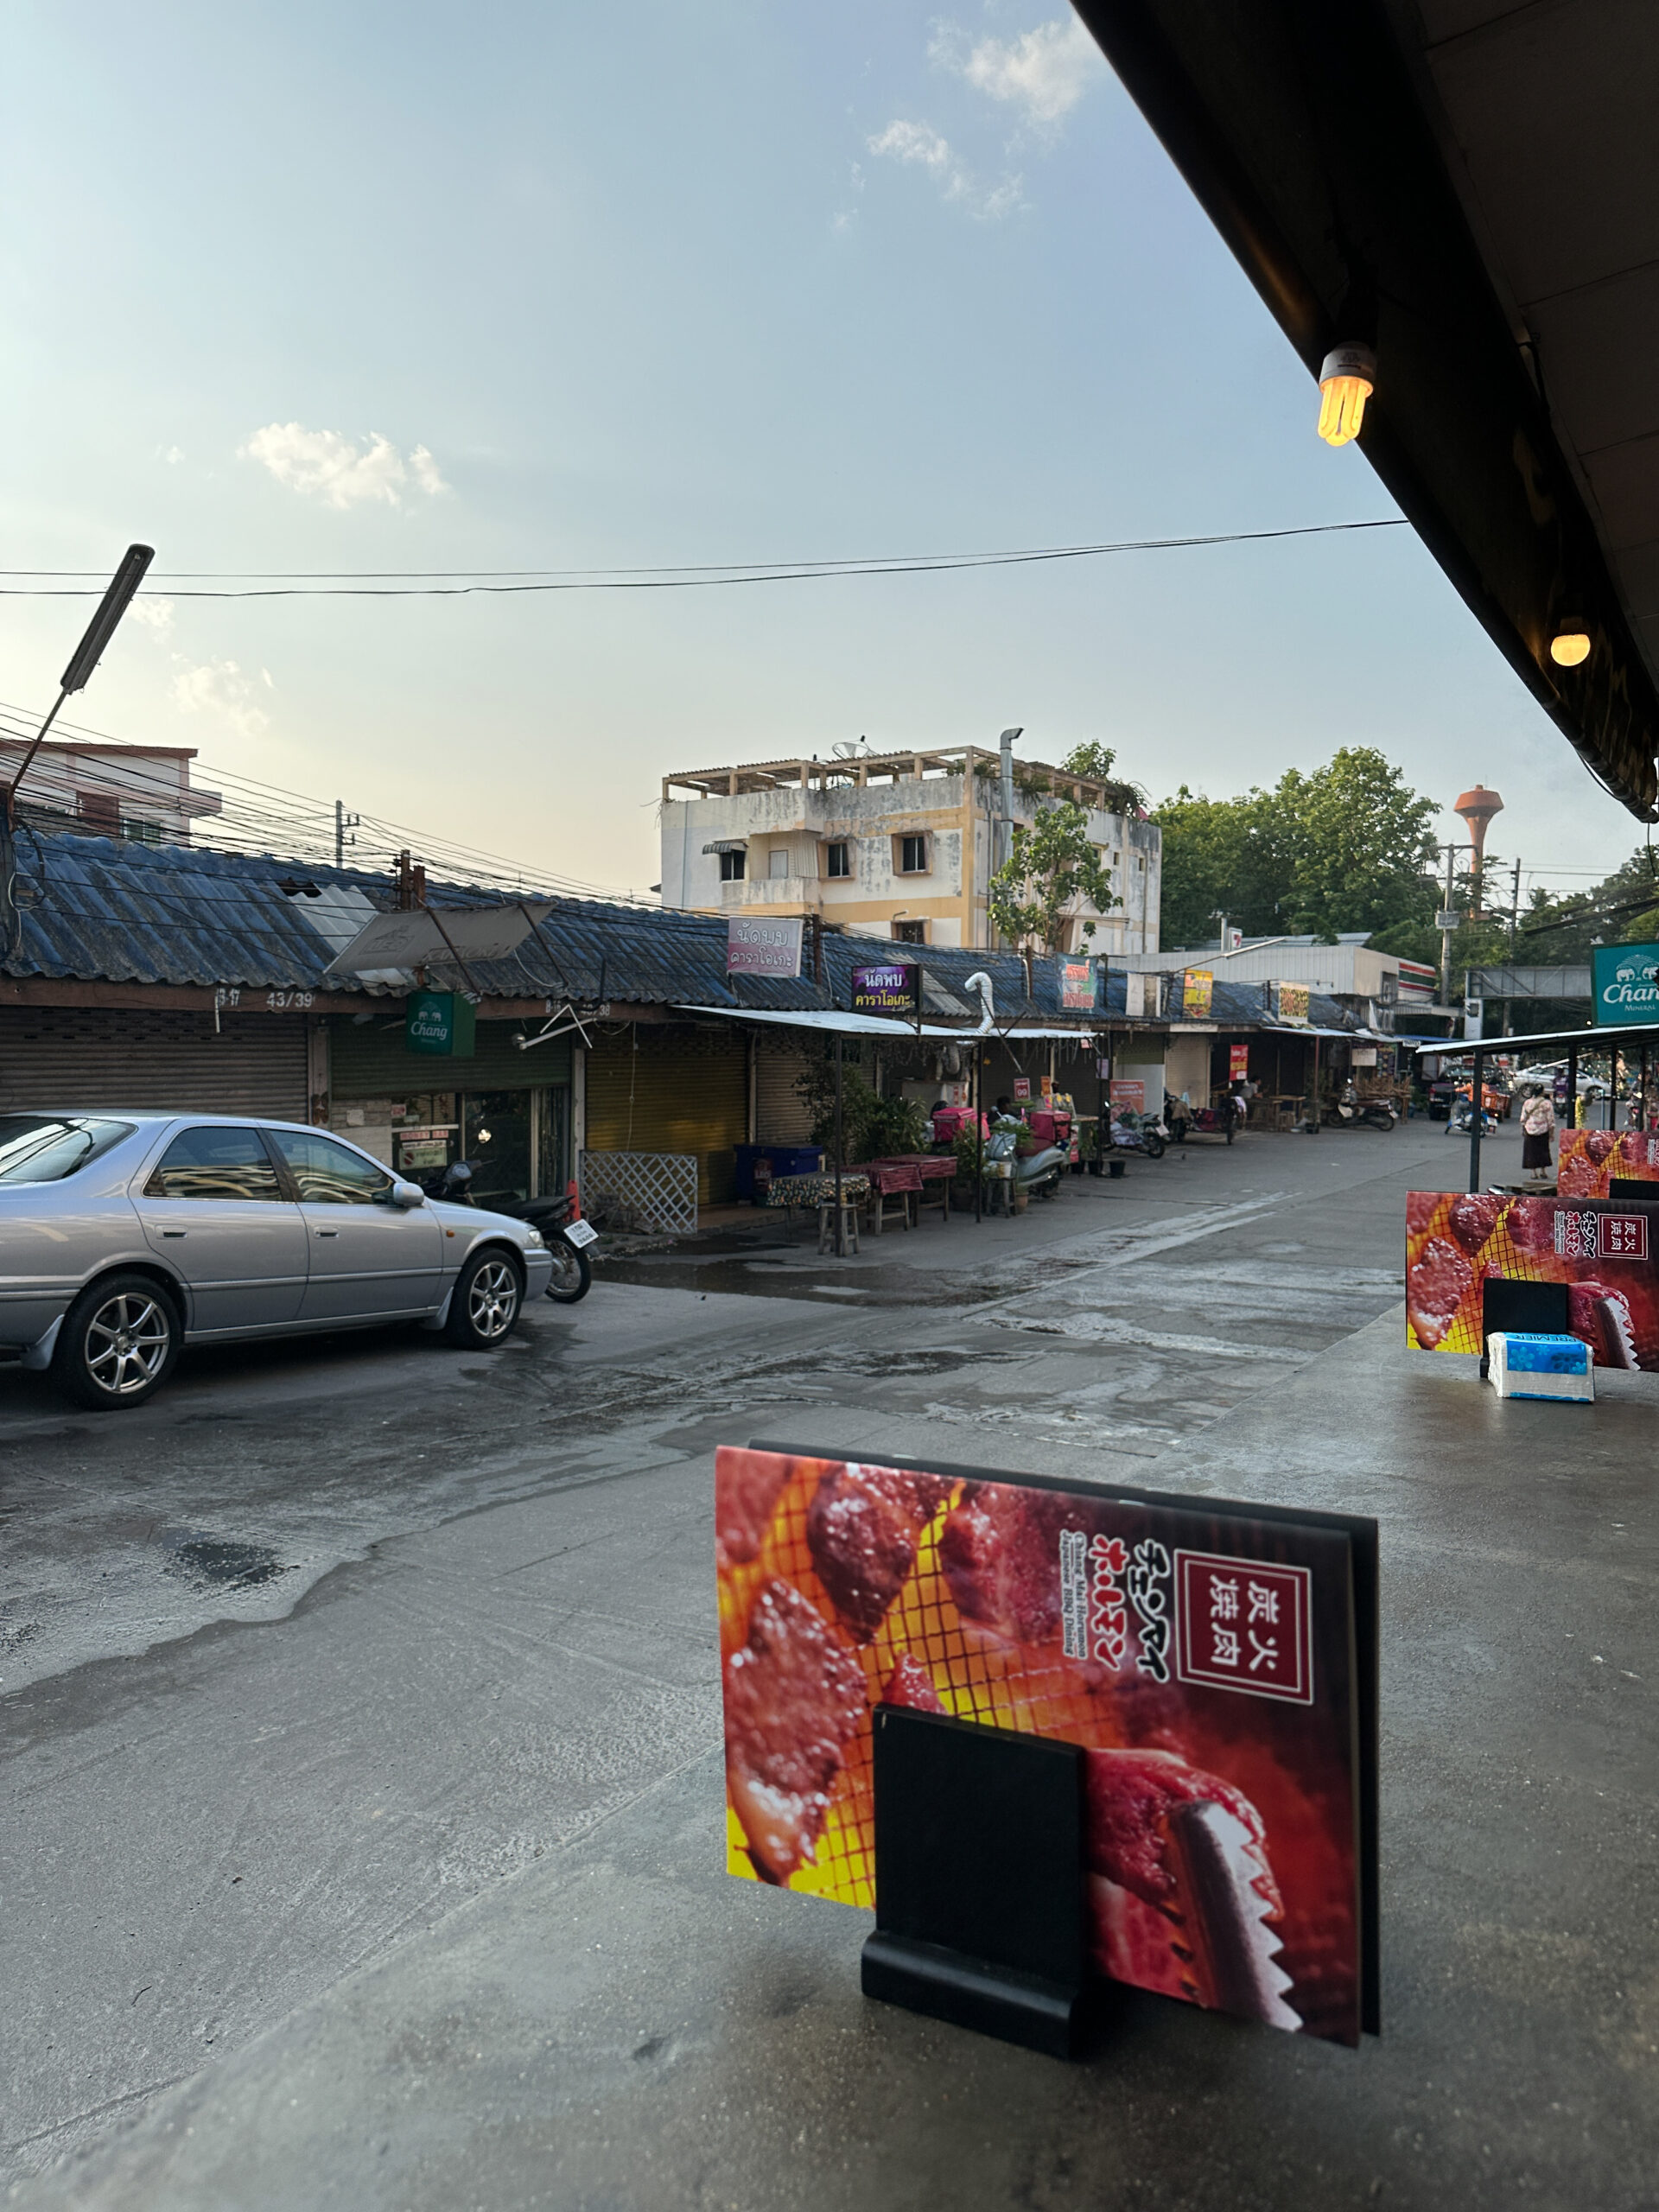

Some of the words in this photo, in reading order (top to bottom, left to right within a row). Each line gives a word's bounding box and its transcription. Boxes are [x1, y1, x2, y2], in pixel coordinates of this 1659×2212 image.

[737, 921, 788, 945] นัดพบ
[731, 945, 792, 967] คาราโอเกะ
[864, 969, 903, 987] นัดพบ
[266, 992, 312, 1007] 43/39
[855, 990, 912, 1007] คาราโอเกะ
[410, 1021, 448, 1040] Chang
[1624, 1221, 1636, 1251] 炭火
[1063, 1588, 1073, 1614] BBQ
[1076, 1580, 1086, 1602] Mai
[1090, 1535, 1128, 1670] ホルモン
[1129, 1541, 1169, 1681] チェンマイ
[1210, 1574, 1241, 1668] 焼肉
[1064, 1617, 1074, 1656] Dining
[1077, 1605, 1087, 1658] Horumon
[1248, 1580, 1280, 1671] 炭火
